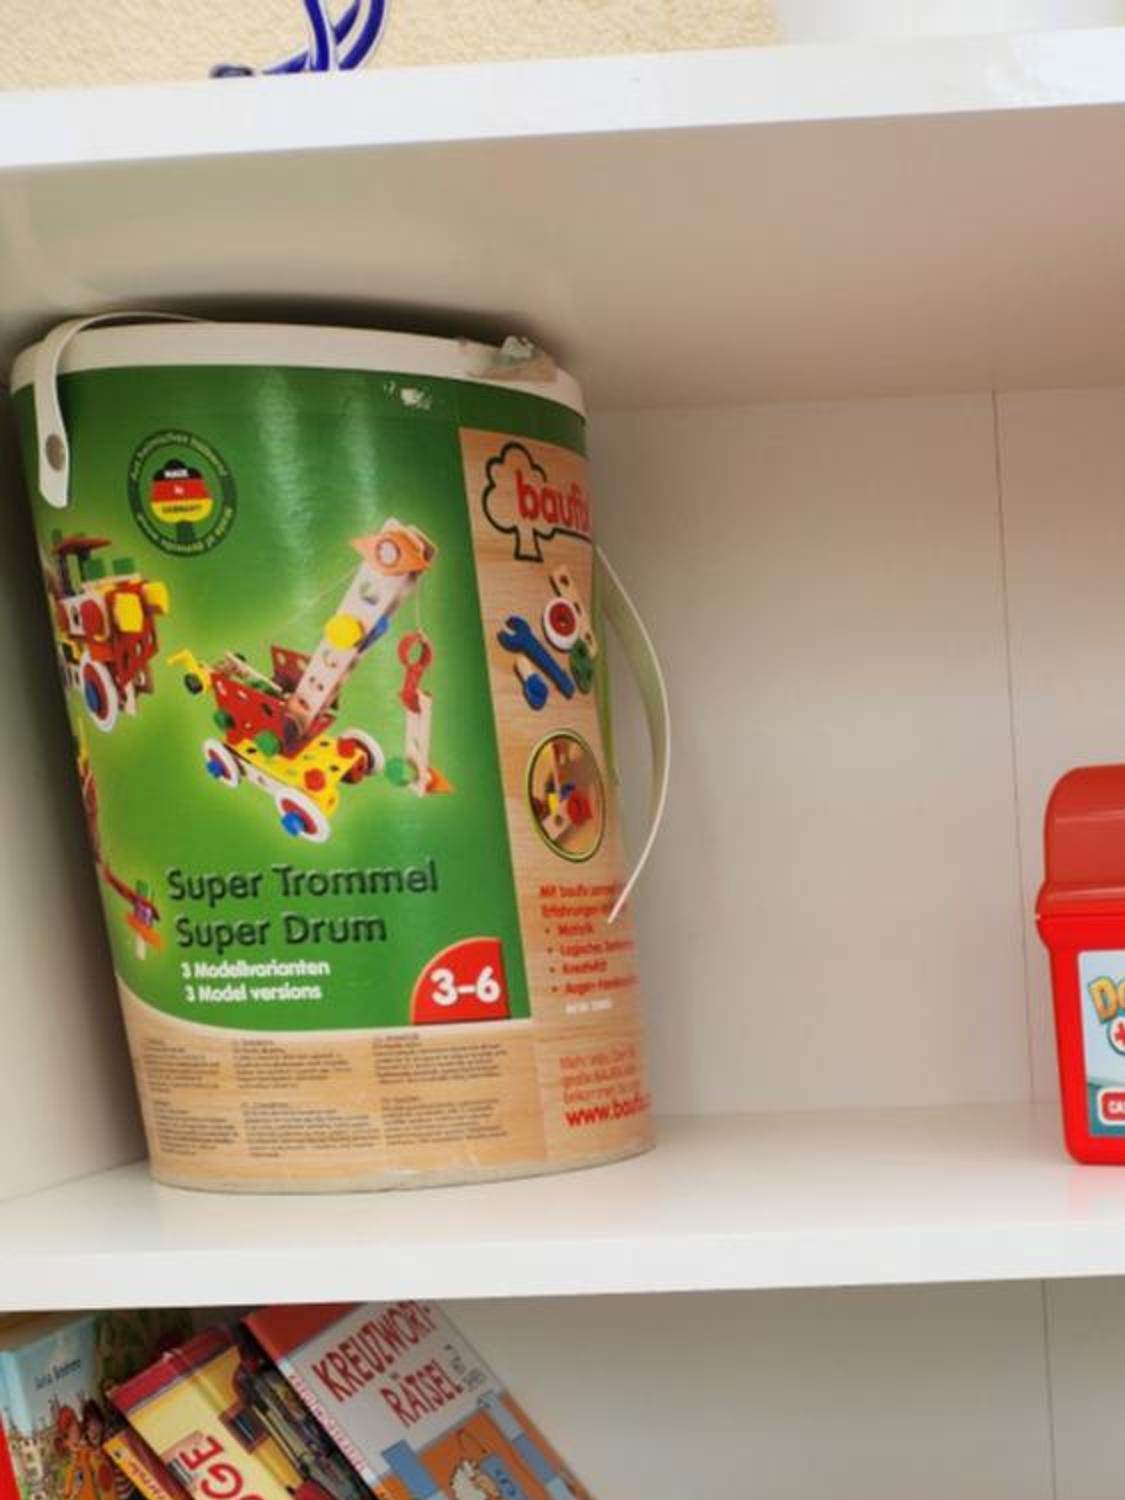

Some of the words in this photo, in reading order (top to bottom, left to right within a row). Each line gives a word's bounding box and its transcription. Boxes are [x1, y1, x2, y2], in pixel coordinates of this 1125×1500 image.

[167, 867, 263, 908] Super
[273, 858, 438, 897] Trommel
[176, 917, 270, 954] Super
[283, 913, 387, 944] Drum
[181, 962, 191, 978] 3
[194, 959, 331, 979] Modellvarianten
[186, 986, 195, 1002] 3
[199, 984, 247, 1002] Model
[249, 982, 323, 1001] versions
